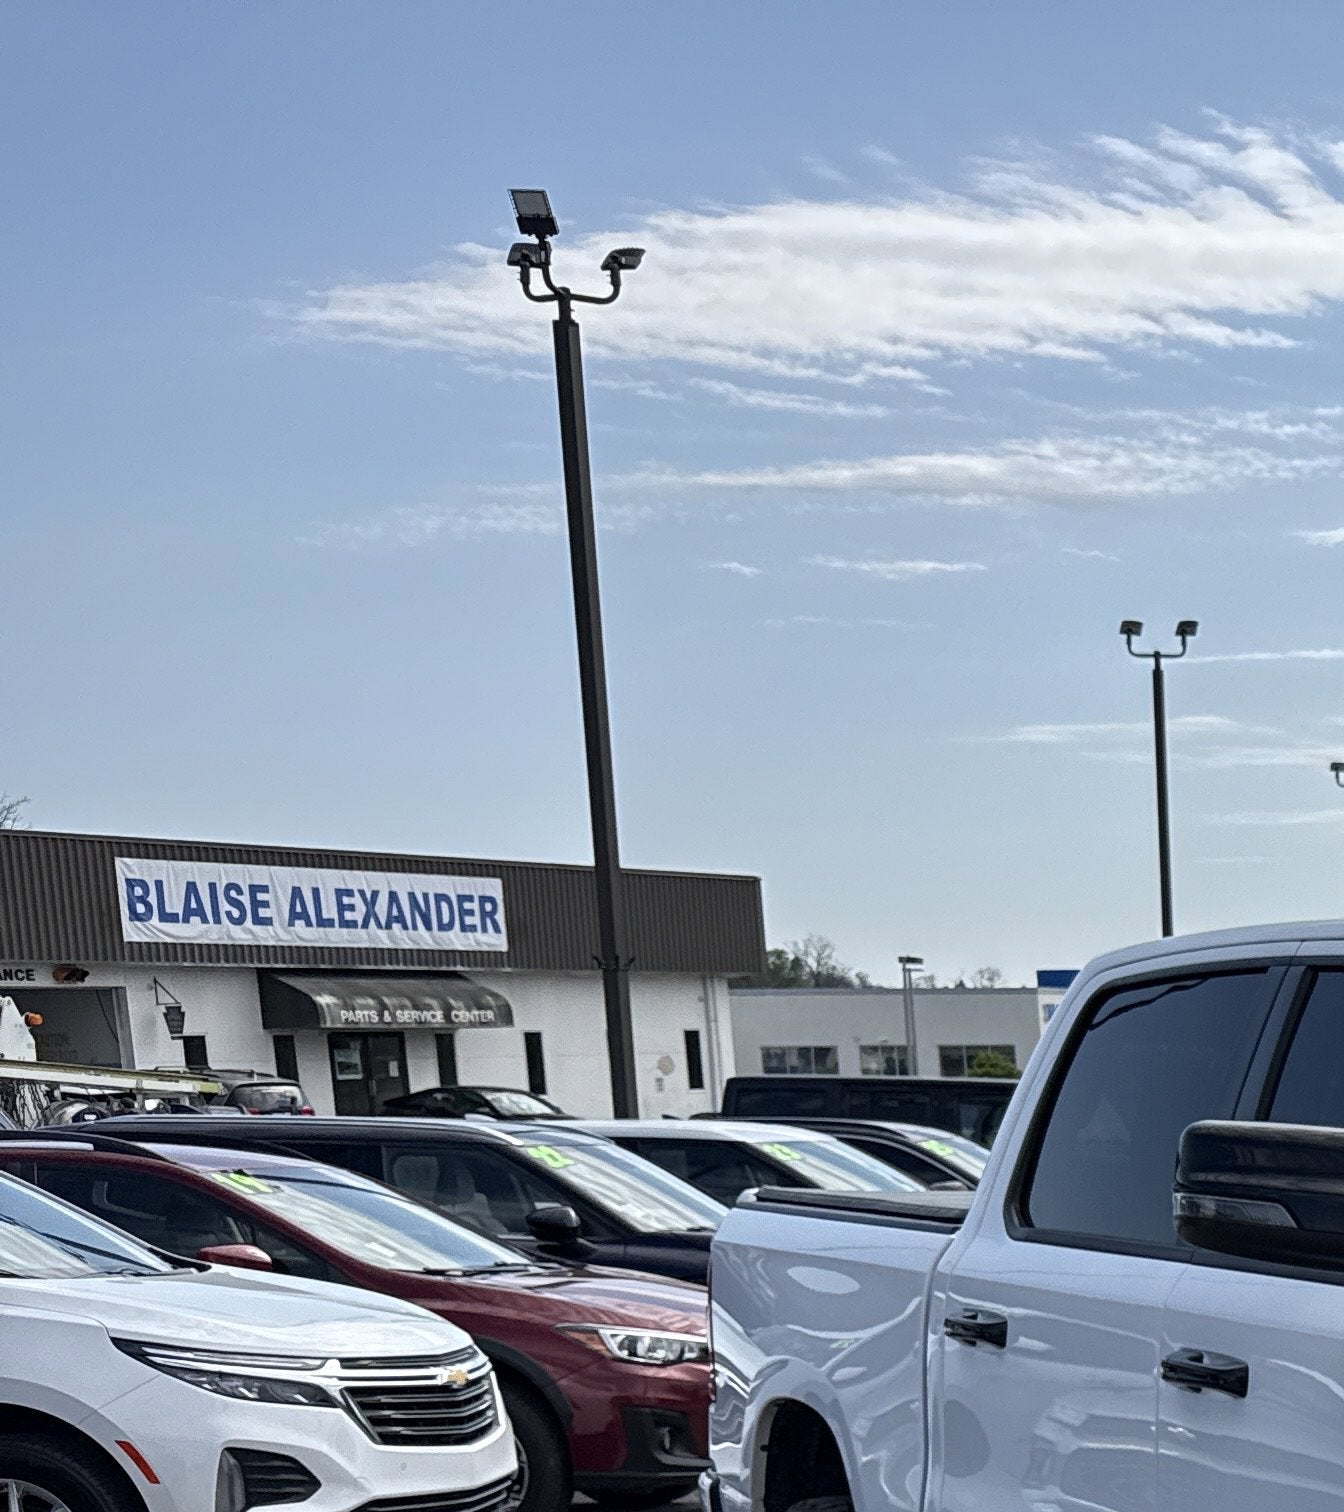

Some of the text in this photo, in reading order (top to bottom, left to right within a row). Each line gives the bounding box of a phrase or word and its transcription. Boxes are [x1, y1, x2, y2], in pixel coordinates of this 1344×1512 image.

[125, 878, 502, 934] BLAISE ALEXANDER
[340, 1010, 495, 1023] PARTS & SERVICE CENTER
